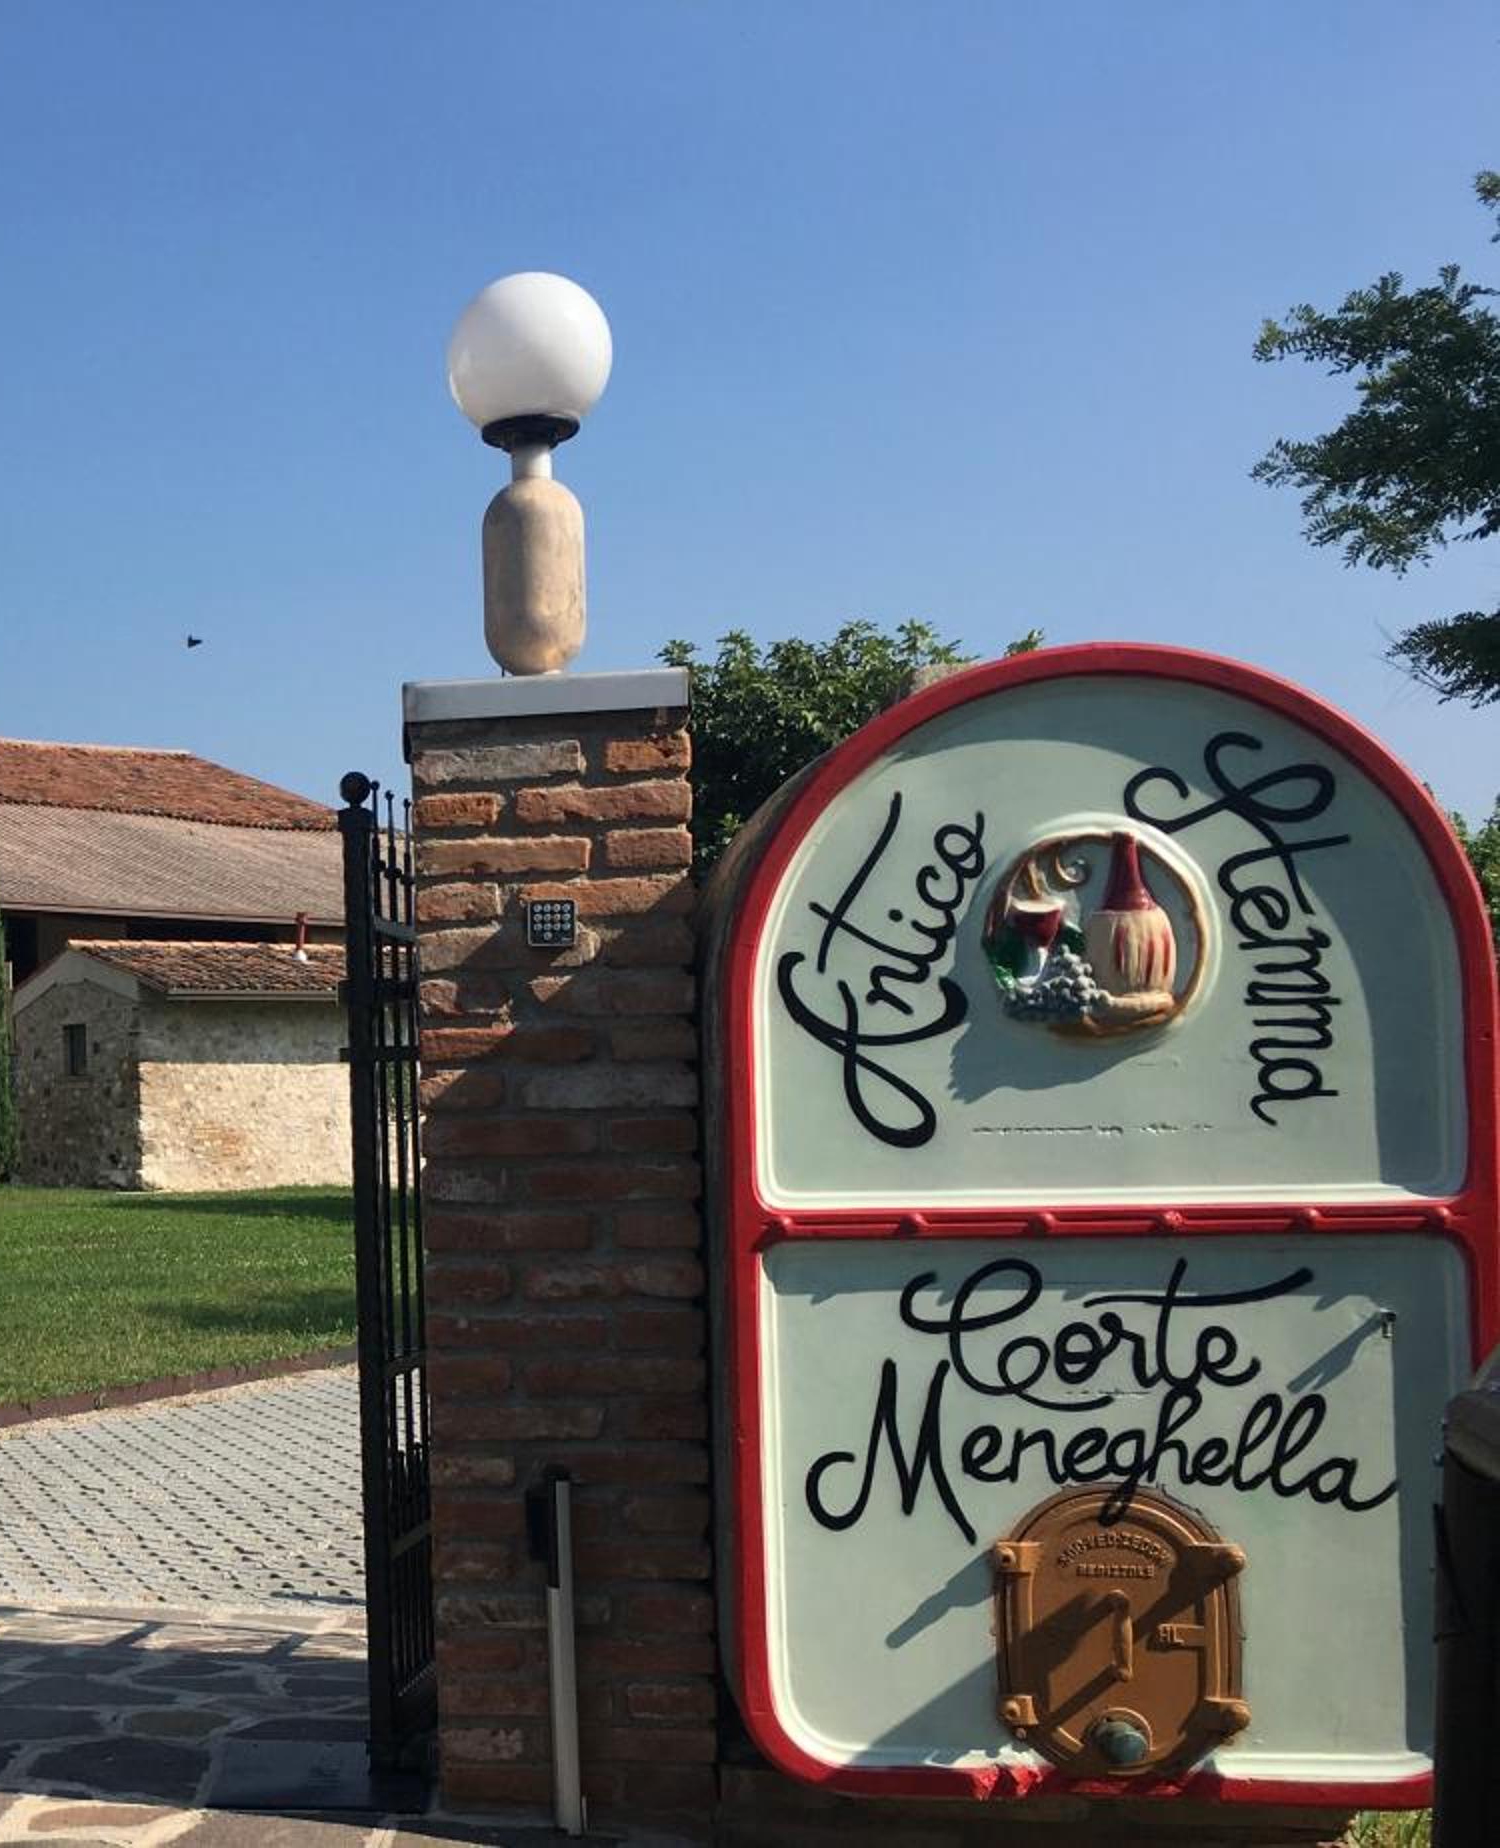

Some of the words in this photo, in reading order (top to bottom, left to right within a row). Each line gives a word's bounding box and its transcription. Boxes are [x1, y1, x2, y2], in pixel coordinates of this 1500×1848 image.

[777, 791, 985, 1149] Antico
[1124, 731, 1352, 1126] Stemma
[900, 1257, 1314, 1412] Corte
[805, 1358, 1399, 1546] Meneghella
